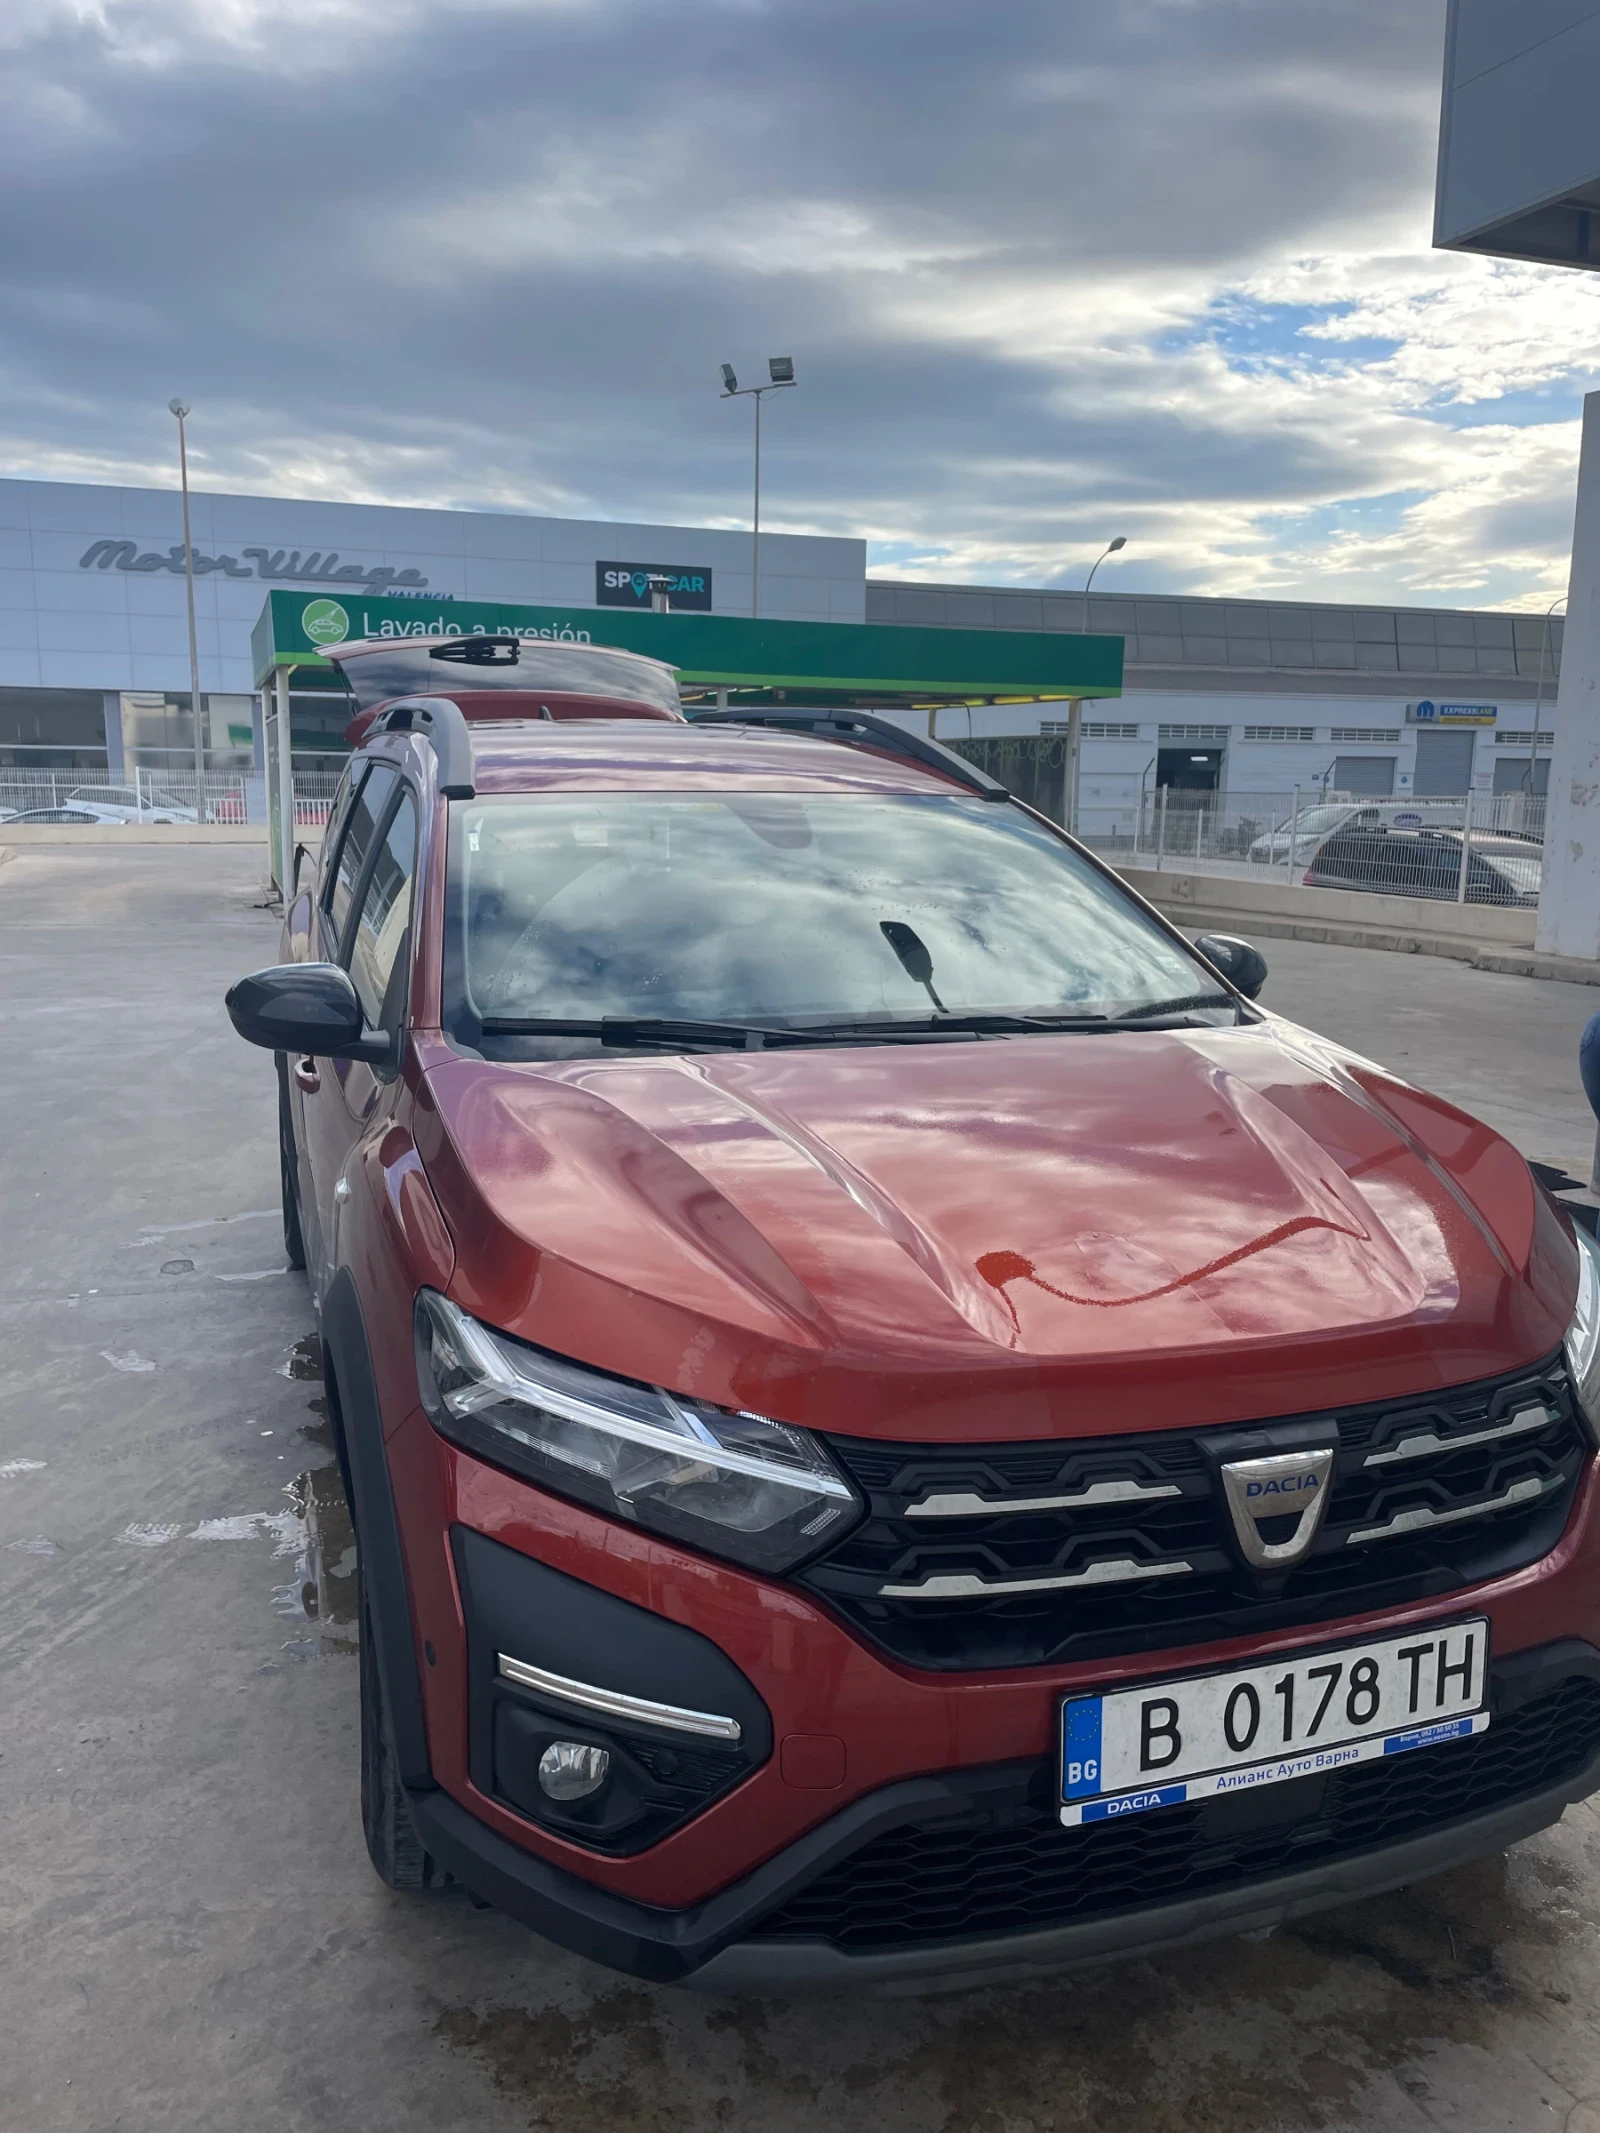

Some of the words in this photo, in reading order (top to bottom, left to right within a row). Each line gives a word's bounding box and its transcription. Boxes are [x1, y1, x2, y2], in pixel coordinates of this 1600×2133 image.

[79, 539, 252, 577] Motor
[243, 547, 429, 595] Village
[363, 612, 461, 636] Lavado
[472, 624, 485, 635] a
[1246, 1474, 1319, 1497] DACIA
[1139, 1697, 1182, 1772] B
[1223, 1656, 1380, 1752] 0178
[1397, 1634, 1474, 1714] TH
[1067, 1759, 1098, 1785] BG
[1216, 1768, 1273, 1790] Алианс
[1276, 1759, 1312, 1779] Ауто
[1316, 1748, 1359, 1768] Варна
[1107, 1793, 1161, 1815] DACIA
